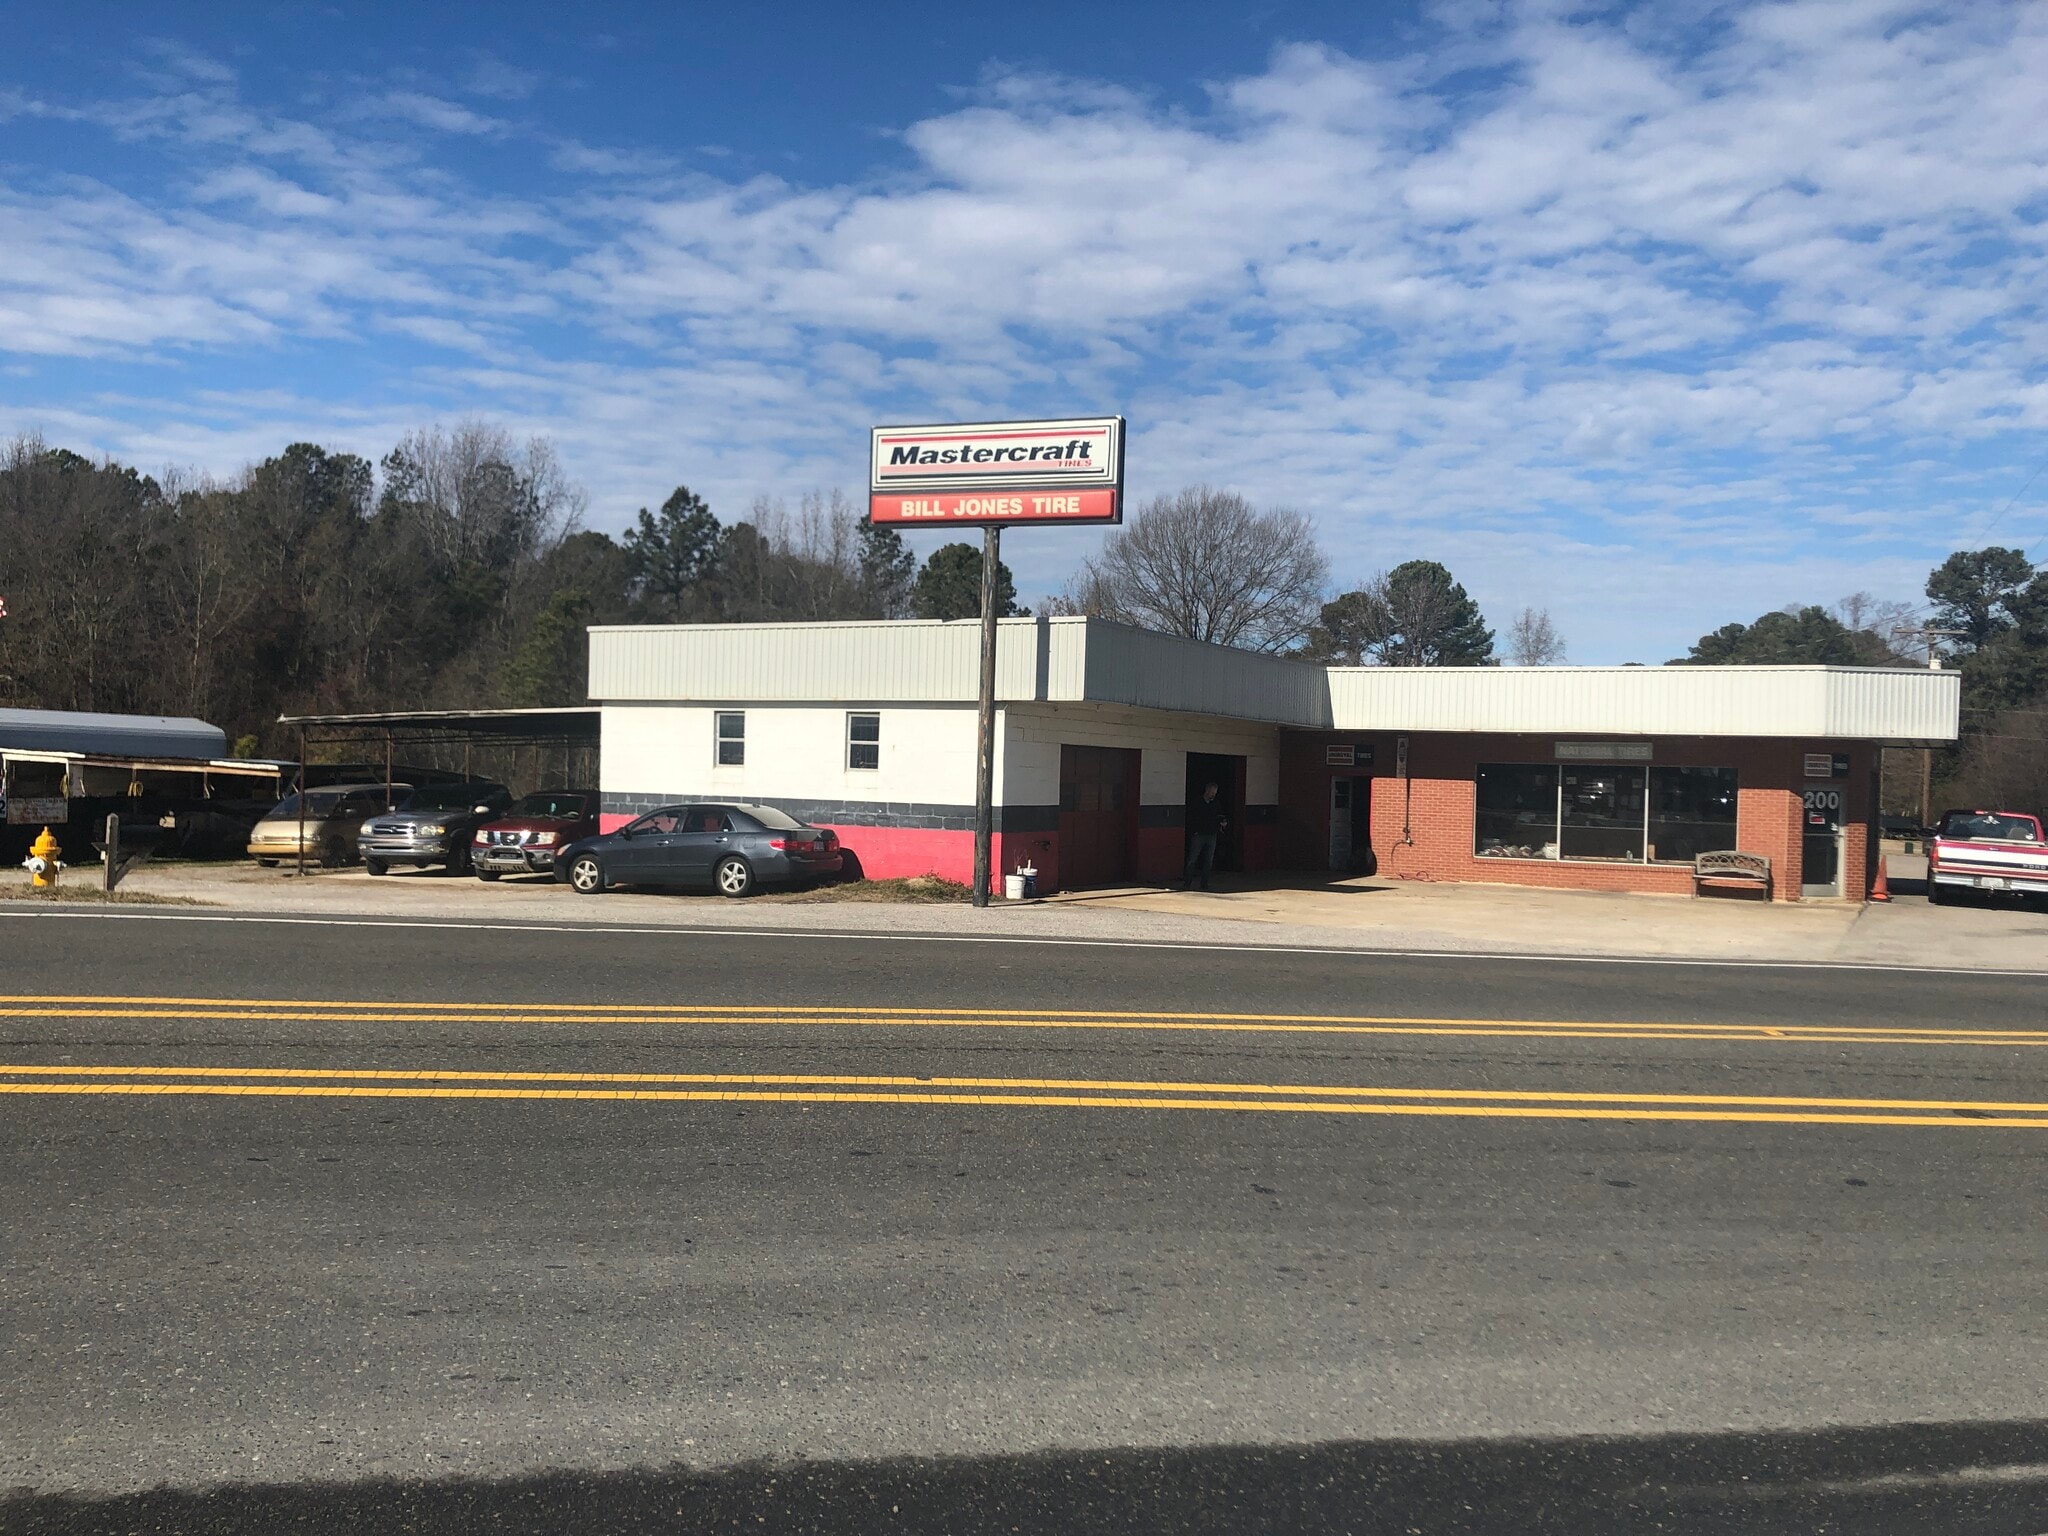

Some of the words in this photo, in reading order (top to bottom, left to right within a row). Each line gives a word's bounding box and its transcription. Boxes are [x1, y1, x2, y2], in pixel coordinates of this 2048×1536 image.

[890, 439, 1092, 465] Mastercraft
[901, 500, 945, 517] BILL
[953, 498, 1023, 516] JONES
[1032, 496, 1081, 514] TIRE
[1804, 791, 1839, 809] 200
